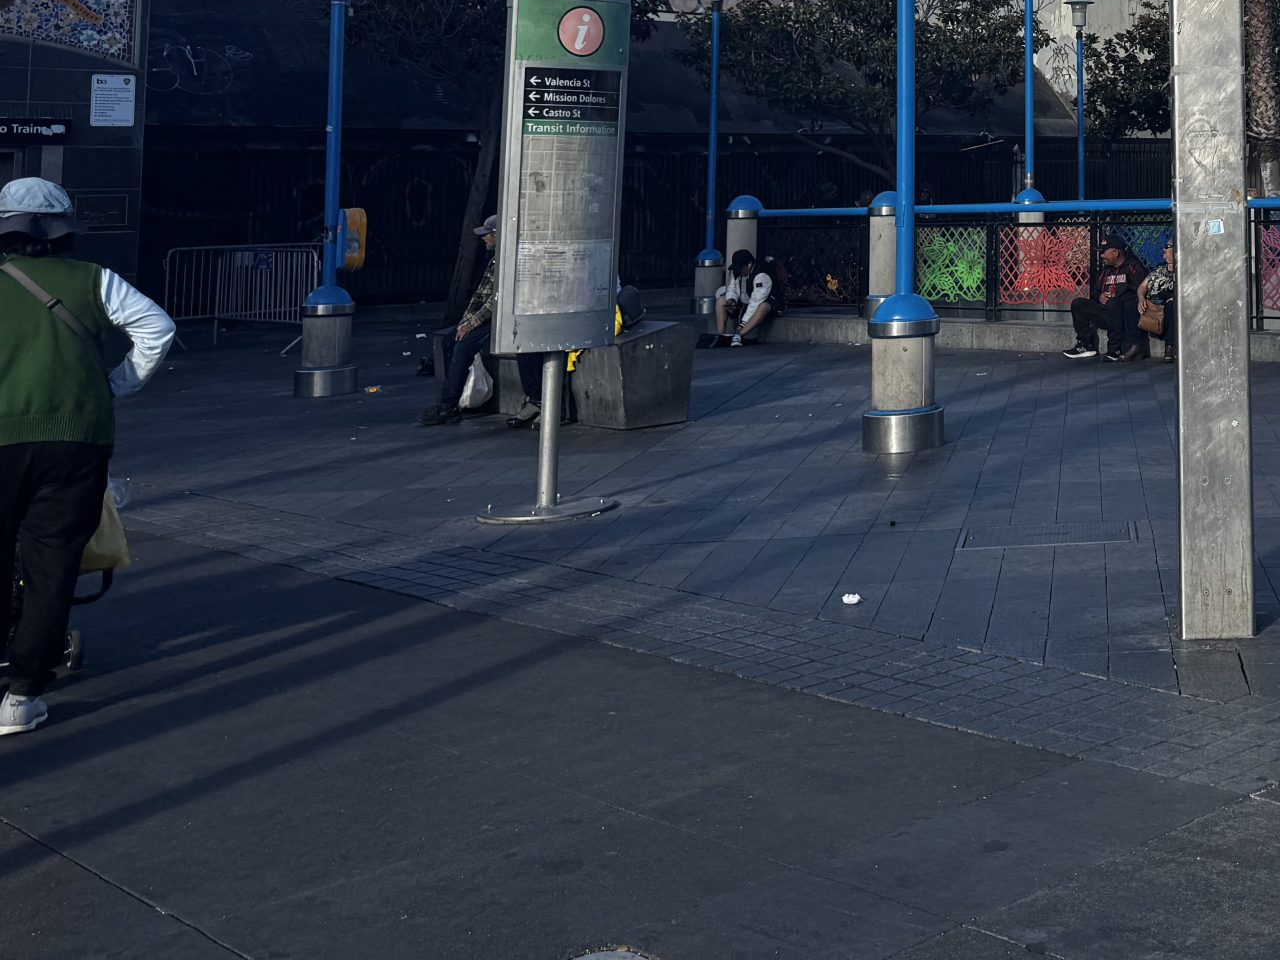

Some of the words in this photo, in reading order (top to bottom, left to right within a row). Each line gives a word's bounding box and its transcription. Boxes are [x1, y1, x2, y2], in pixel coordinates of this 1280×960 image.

[544, 77, 582, 87] Valencia
[582, 79, 591, 88] St
[543, 92, 578, 103] Mission
[579, 94, 606, 104] Dolores
[542, 108, 571, 118] Castro
[572, 109, 581, 118] St
[526, 123, 563, 133] Transit
[566, 123, 616, 134] Information
